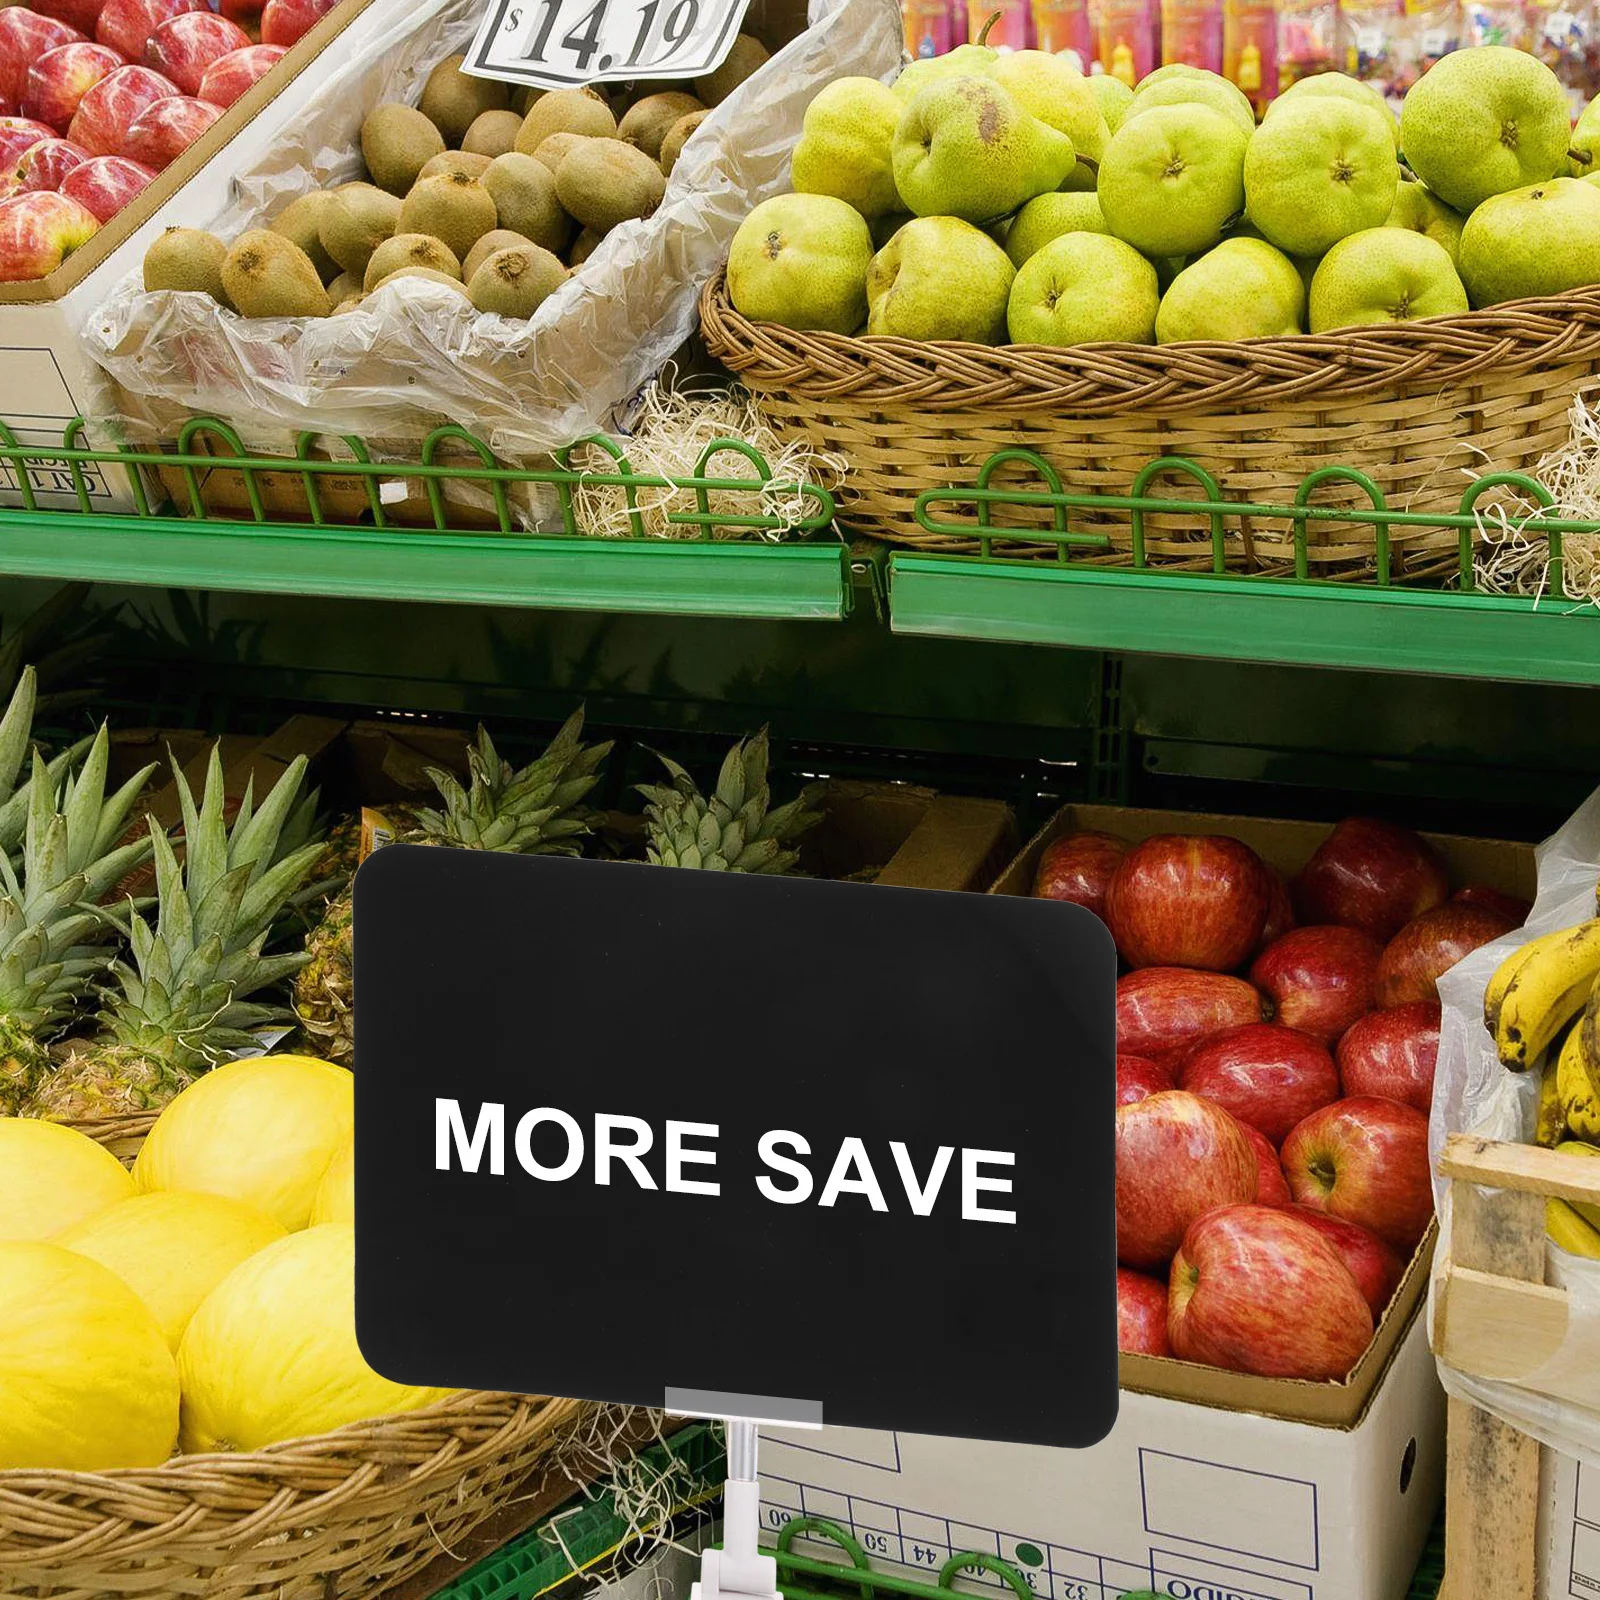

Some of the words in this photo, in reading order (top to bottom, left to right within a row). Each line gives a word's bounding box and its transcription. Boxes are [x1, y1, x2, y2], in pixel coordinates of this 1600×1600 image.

[435, 1097, 720, 1196] MORE
[756, 1129, 1017, 1224] SAVE
[865, 1533, 887, 1553] 50
[913, 1545, 937, 1565] 44
